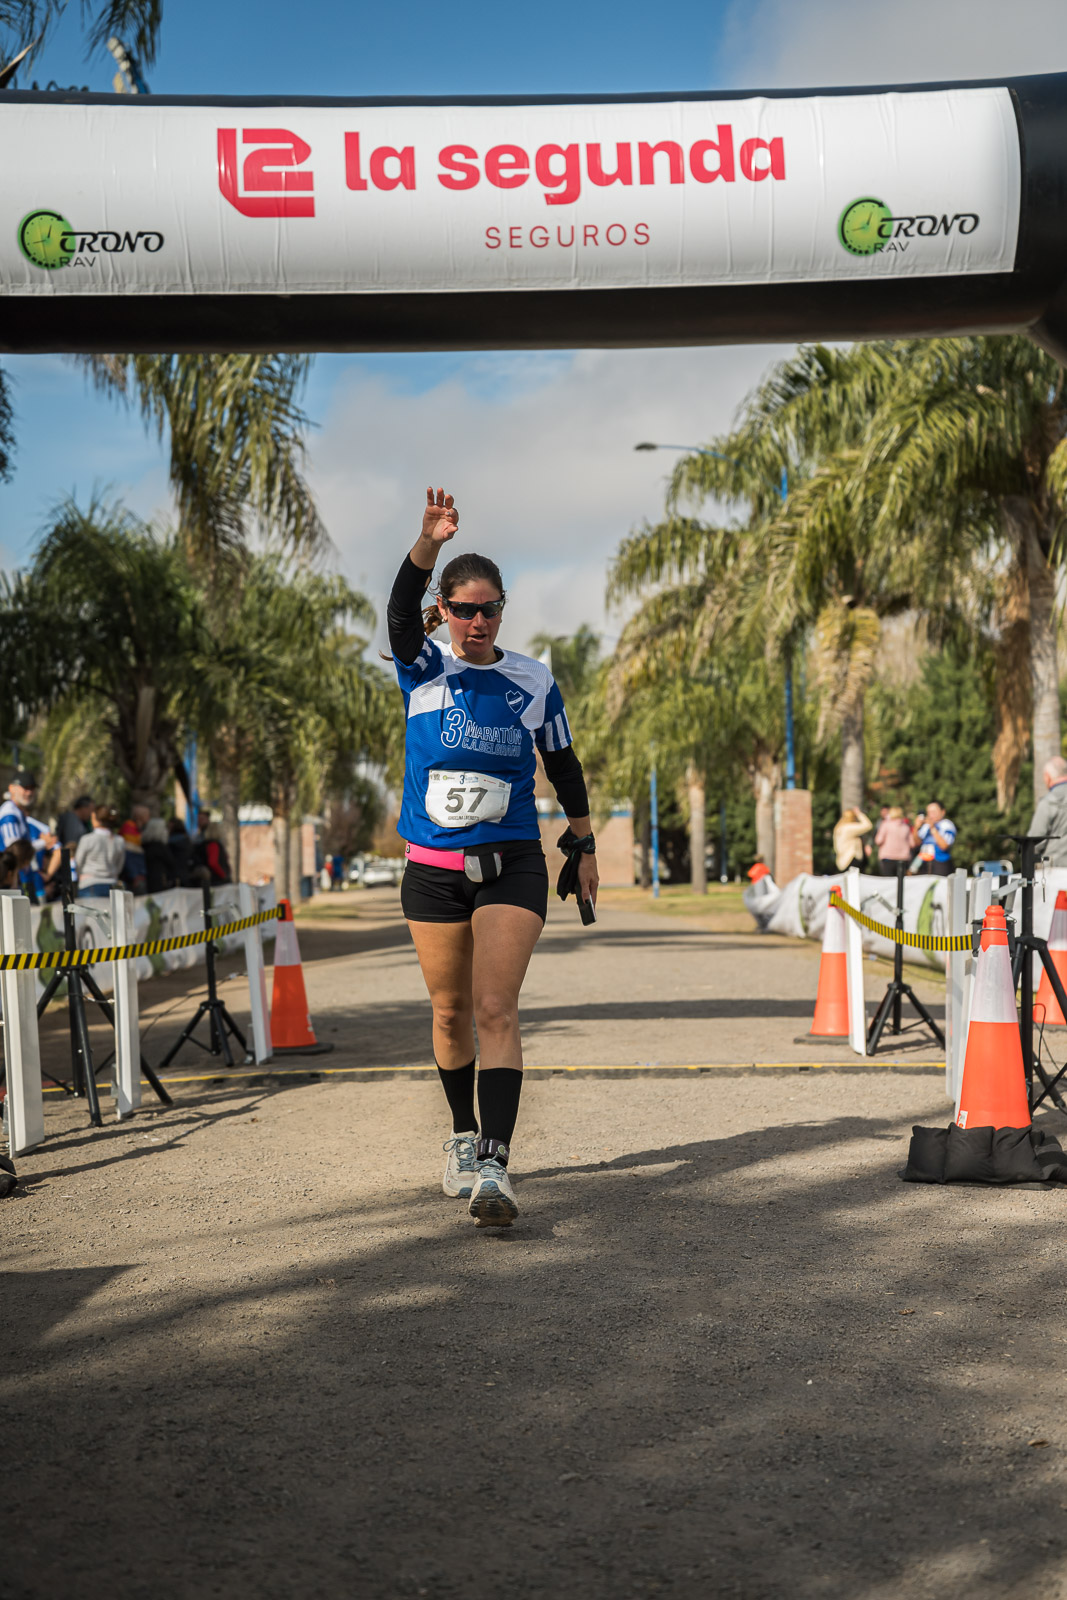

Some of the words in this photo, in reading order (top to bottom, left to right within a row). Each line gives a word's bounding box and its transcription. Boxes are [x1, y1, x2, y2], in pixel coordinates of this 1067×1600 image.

[344, 131, 417, 192] la
[437, 124, 787, 206] segunda
[484, 222, 651, 250] SEGUROS
[876, 213, 981, 239] CRONO
[59, 230, 165, 253] CRONO
[872, 241, 910, 253] RAV
[59, 255, 97, 268] RAV
[441, 708, 466, 748] 3
[445, 787, 488, 813] 57
